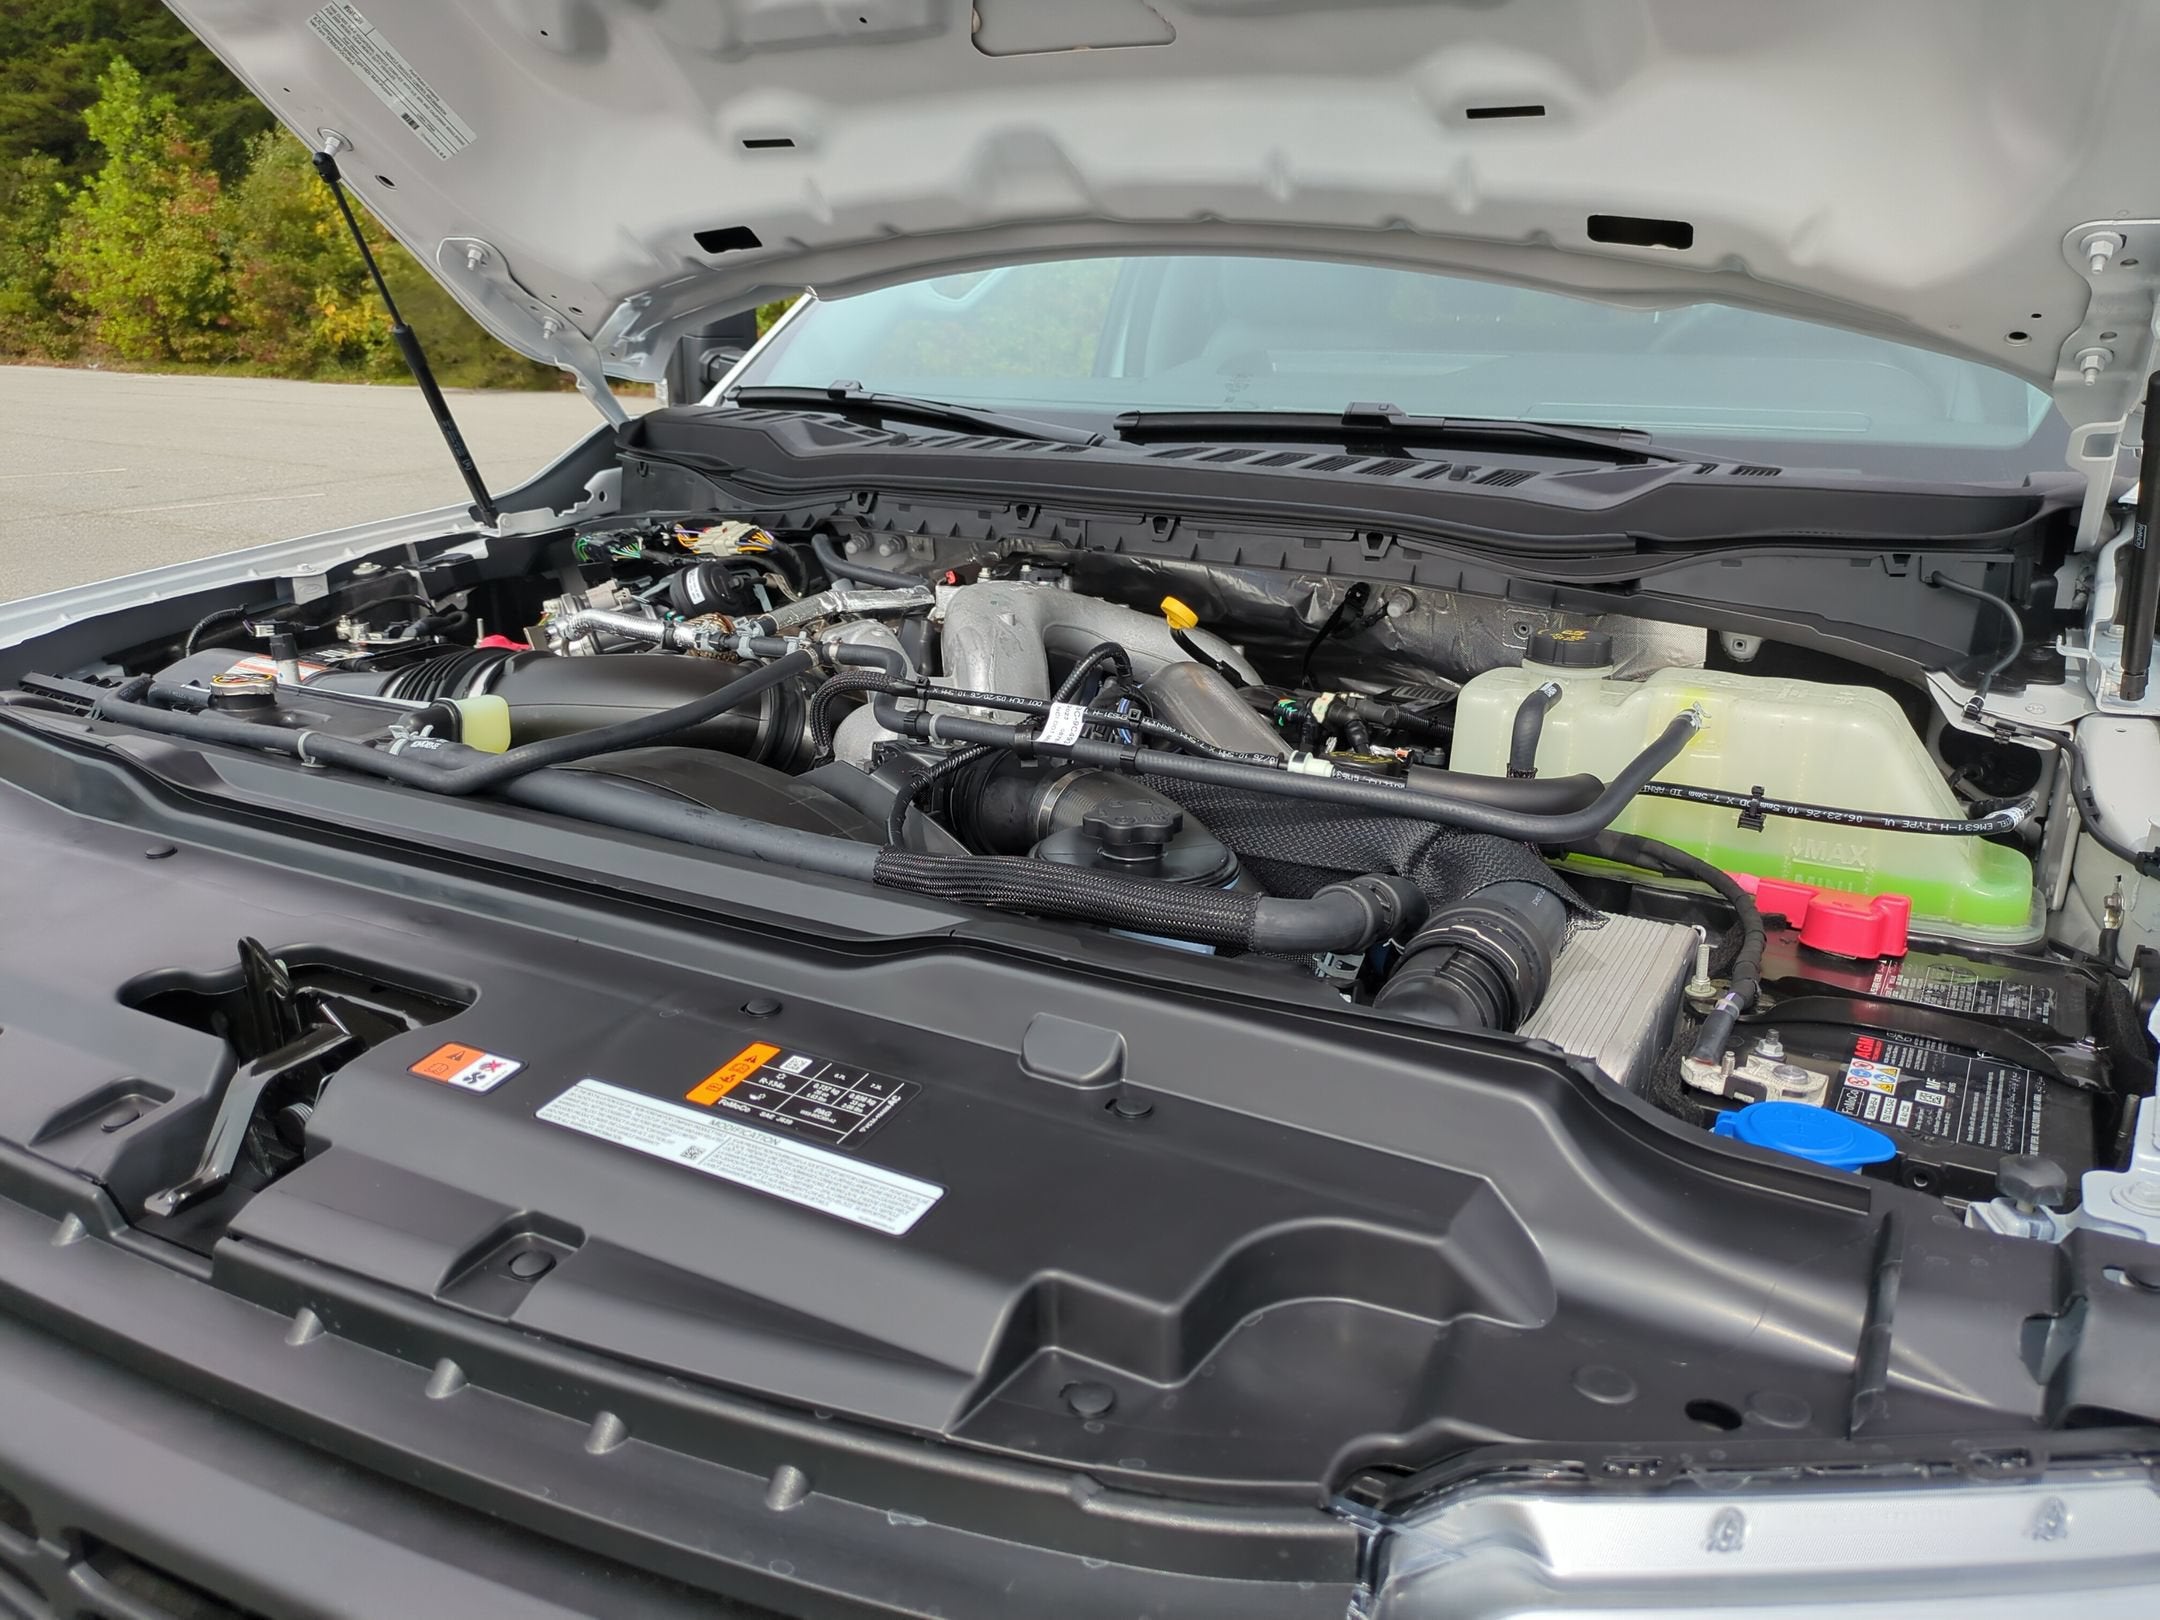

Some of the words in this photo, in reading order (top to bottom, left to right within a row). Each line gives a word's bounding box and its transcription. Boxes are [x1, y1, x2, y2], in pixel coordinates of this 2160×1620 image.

[1940, 822, 1993, 831] EM631-H
[1805, 838, 1866, 866] MAX
[1853, 1035, 1874, 1059] AGM
[718, 1099, 751, 1113] FoMoCo
[1841, 1087, 1858, 1114] FoMoCo
[708, 1119, 782, 1146] MODIFICATION
